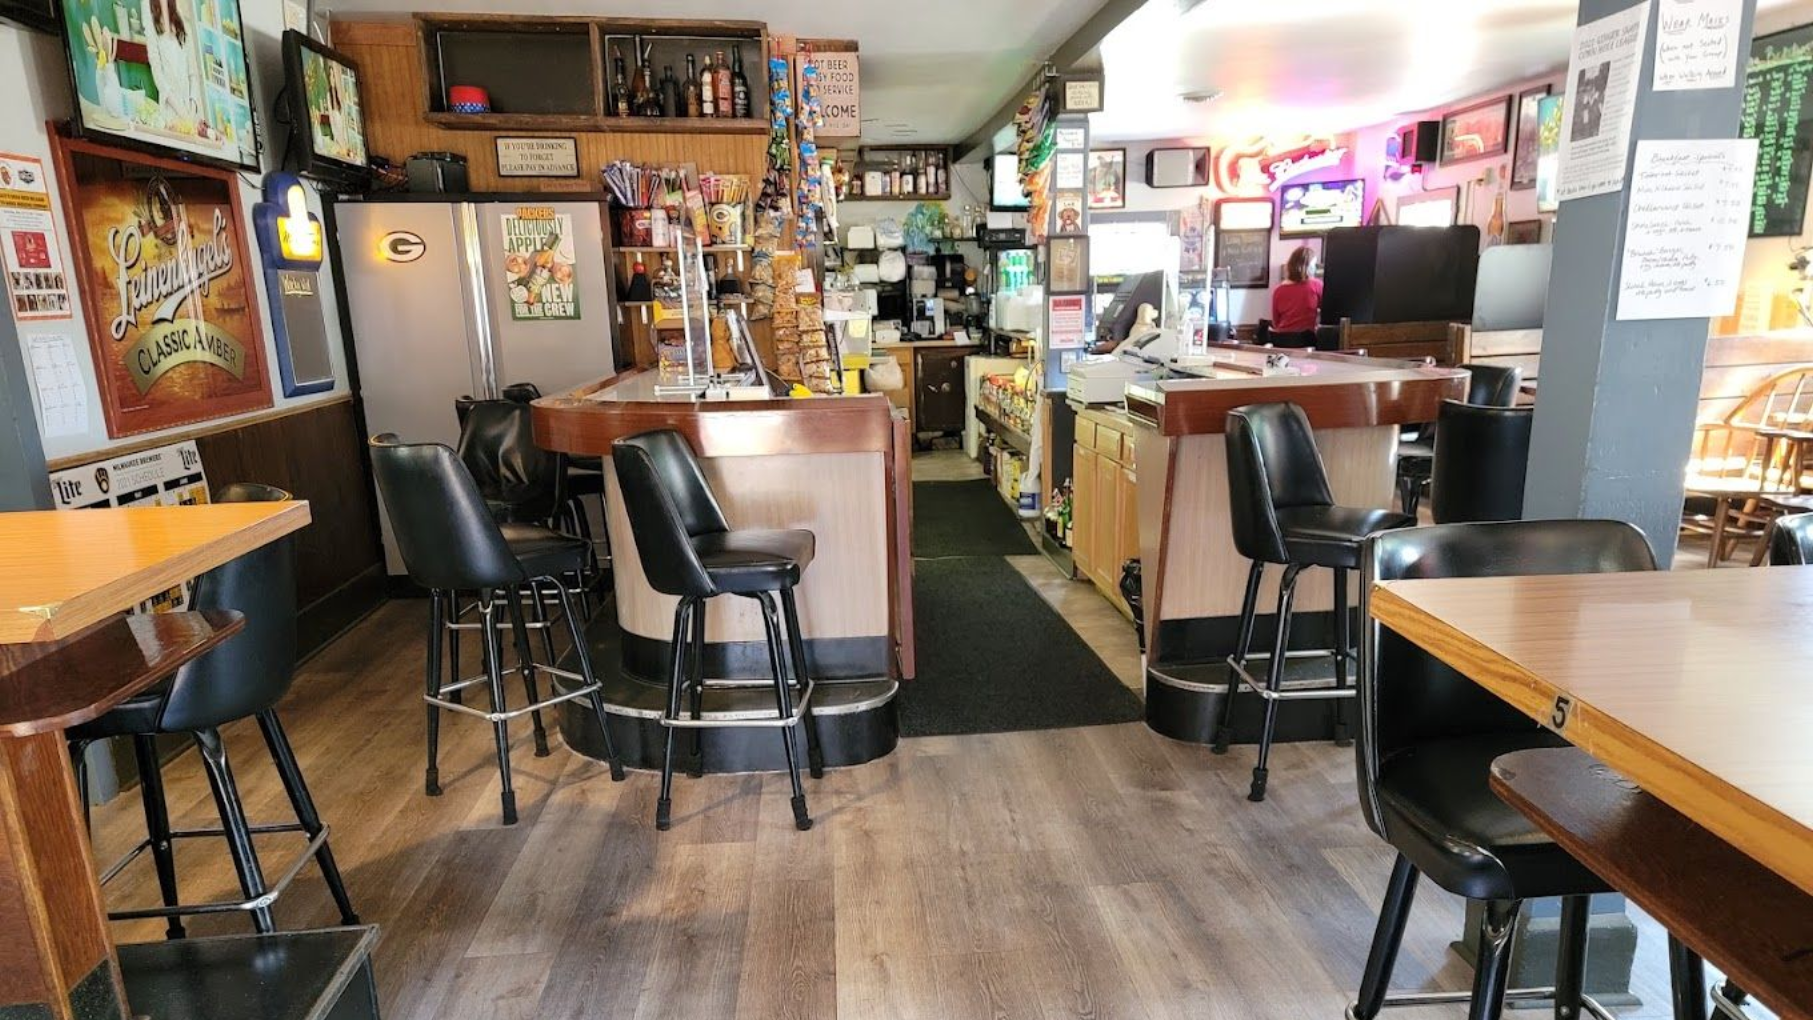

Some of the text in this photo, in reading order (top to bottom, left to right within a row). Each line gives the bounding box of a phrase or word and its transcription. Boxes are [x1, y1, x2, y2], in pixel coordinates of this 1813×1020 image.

[827, 60, 849, 70] BEER
[830, 72, 854, 82] FOOD
[823, 85, 854, 95] SERVICE
[536, 142, 567, 150] DRINKING
[501, 163, 524, 172] PLEASE
[505, 217, 564, 236] DELICIOUSLY
[108, 207, 234, 341] Leinenkugel's
[542, 283, 574, 302] NEW
[544, 302, 575, 317] CREW
[138, 325, 238, 375] CLASSIC AMBER
[140, 453, 162, 466] BREWERS
[180, 449, 198, 471] Lite
[132, 467, 165, 486] SCHEDULE
[56, 479, 82, 505] Lite
[1552, 696, 1570, 729] 5
